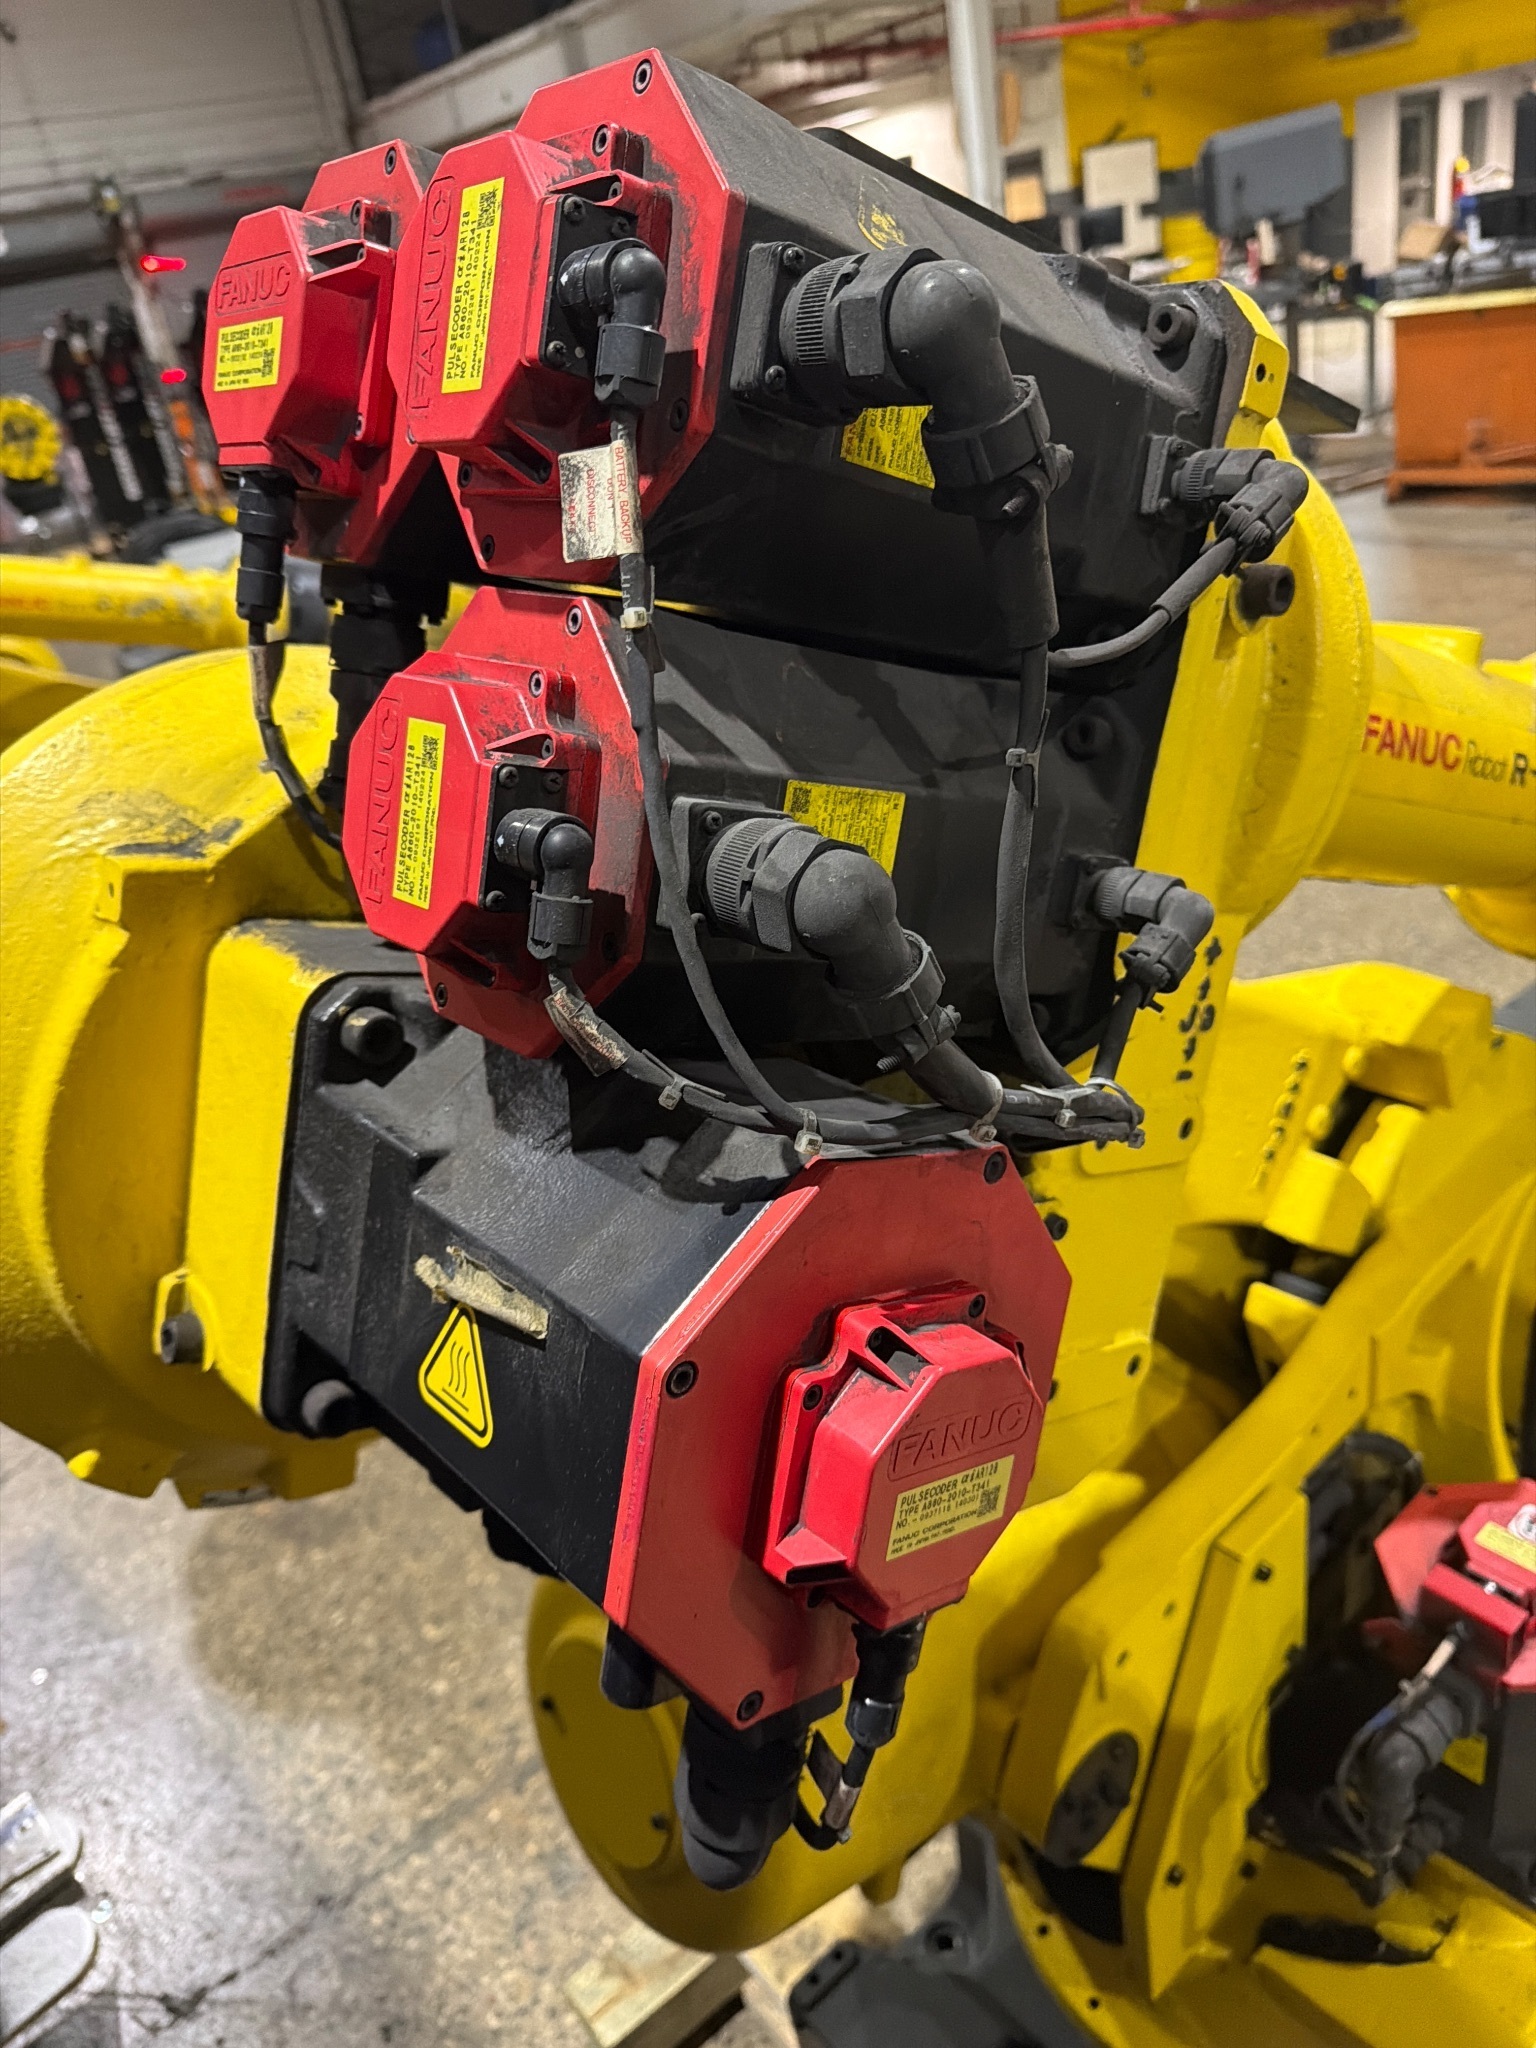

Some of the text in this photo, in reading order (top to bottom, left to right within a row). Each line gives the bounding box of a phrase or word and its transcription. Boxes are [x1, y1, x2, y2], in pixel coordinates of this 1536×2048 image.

[218, 262, 291, 309] FANUC
[411, 188, 451, 414] FANUC
[470, 229, 491, 378] FANUC CORPORATION
[446, 285, 464, 379] PULSECODER
[454, 345, 463, 378] TYPE
[586, 467, 597, 535] DISCONNECT
[614, 446, 629, 494] BATTERY
[619, 500, 633, 544] BACKUP
[621, 572, 632, 655] VEAFIT
[1361, 714, 1463, 772] FANUC
[366, 708, 399, 905] FANUC
[422, 771, 434, 858] CORPORATION
[397, 809, 410, 892] PULSECODER
[402, 864, 411, 894] TYPE
[892, 1402, 1025, 1474] FANUC
[899, 1504, 919, 1518] TYPE
[900, 1480, 958, 1508] PULSECODER
[892, 1510, 978, 1546] FANUC CORPORATION
